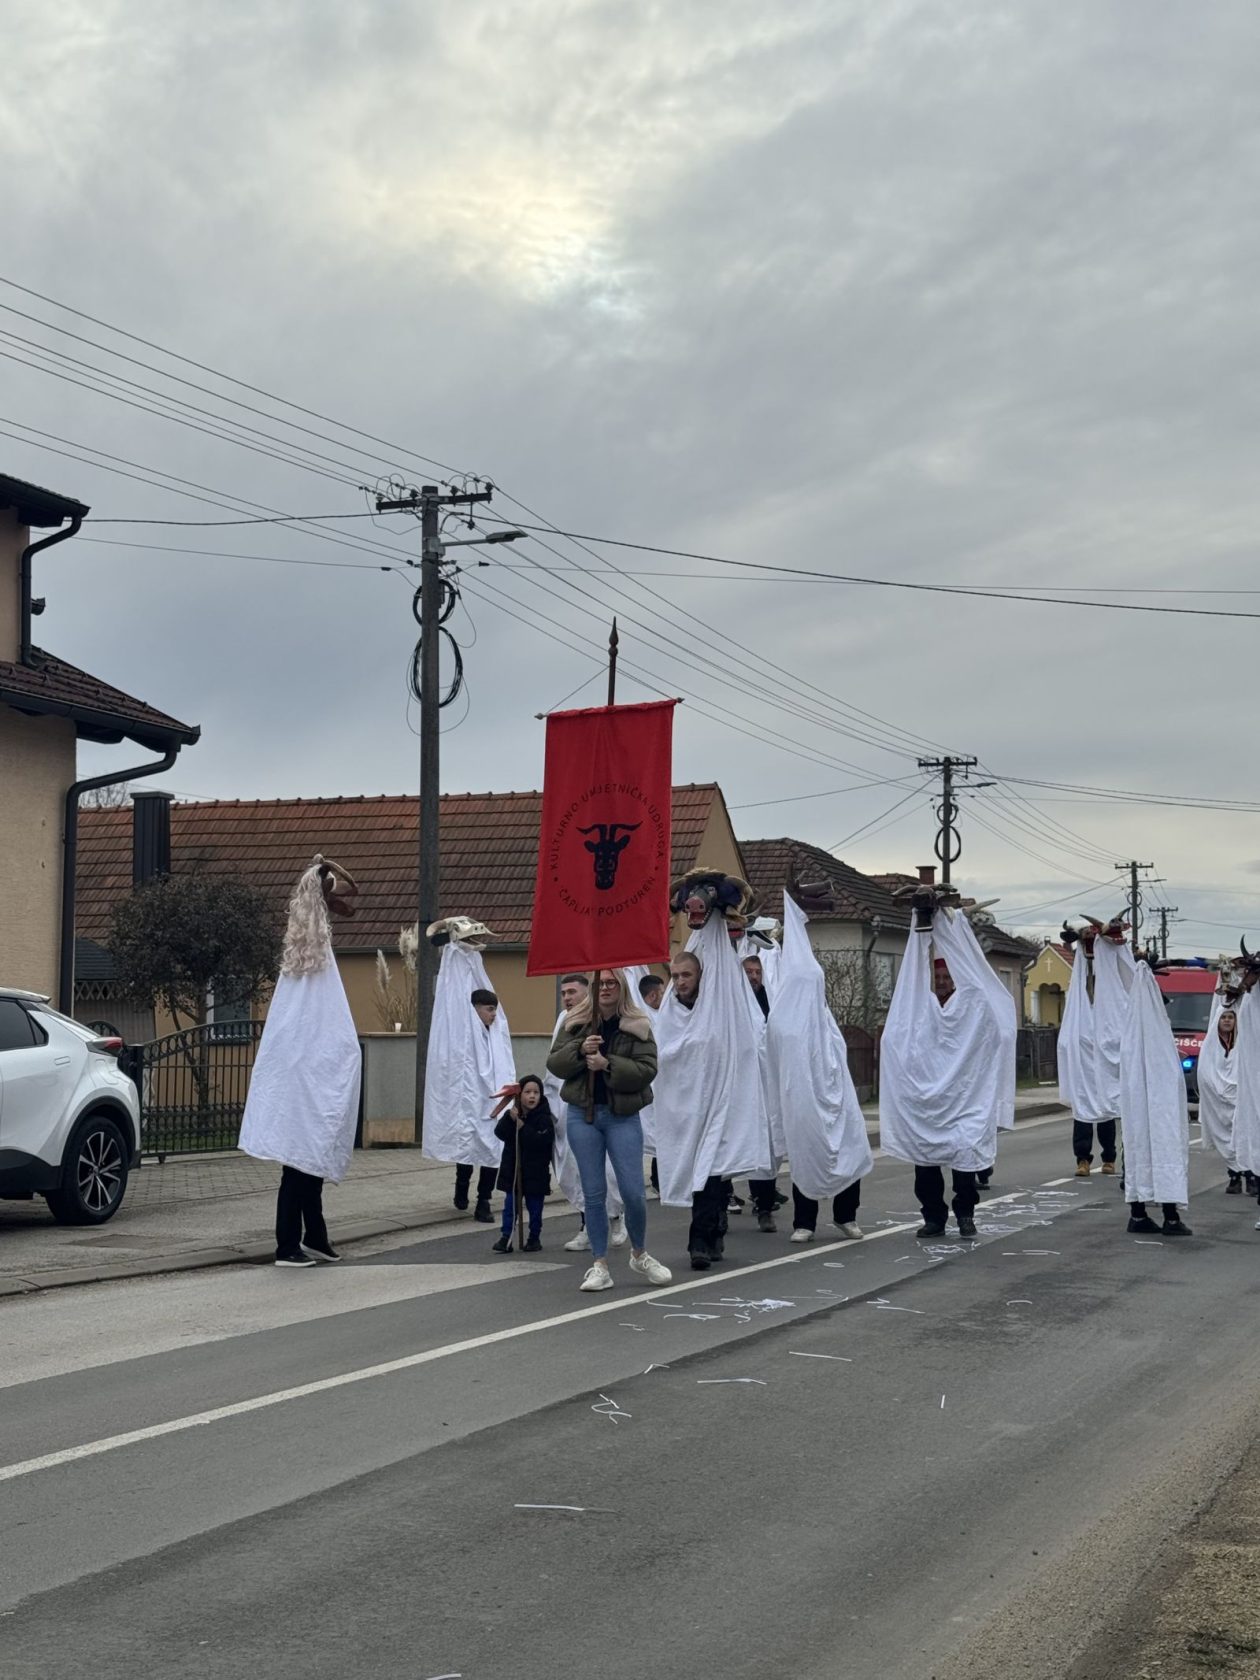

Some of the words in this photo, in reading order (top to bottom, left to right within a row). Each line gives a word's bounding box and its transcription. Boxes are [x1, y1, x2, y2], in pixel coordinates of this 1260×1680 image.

[549, 801, 578, 871] KULTURNO
[581, 783, 648, 806] UMJETNIČKA
[647, 804, 665, 858] UDRUGA
[597, 876, 656, 917] PODTUREN
